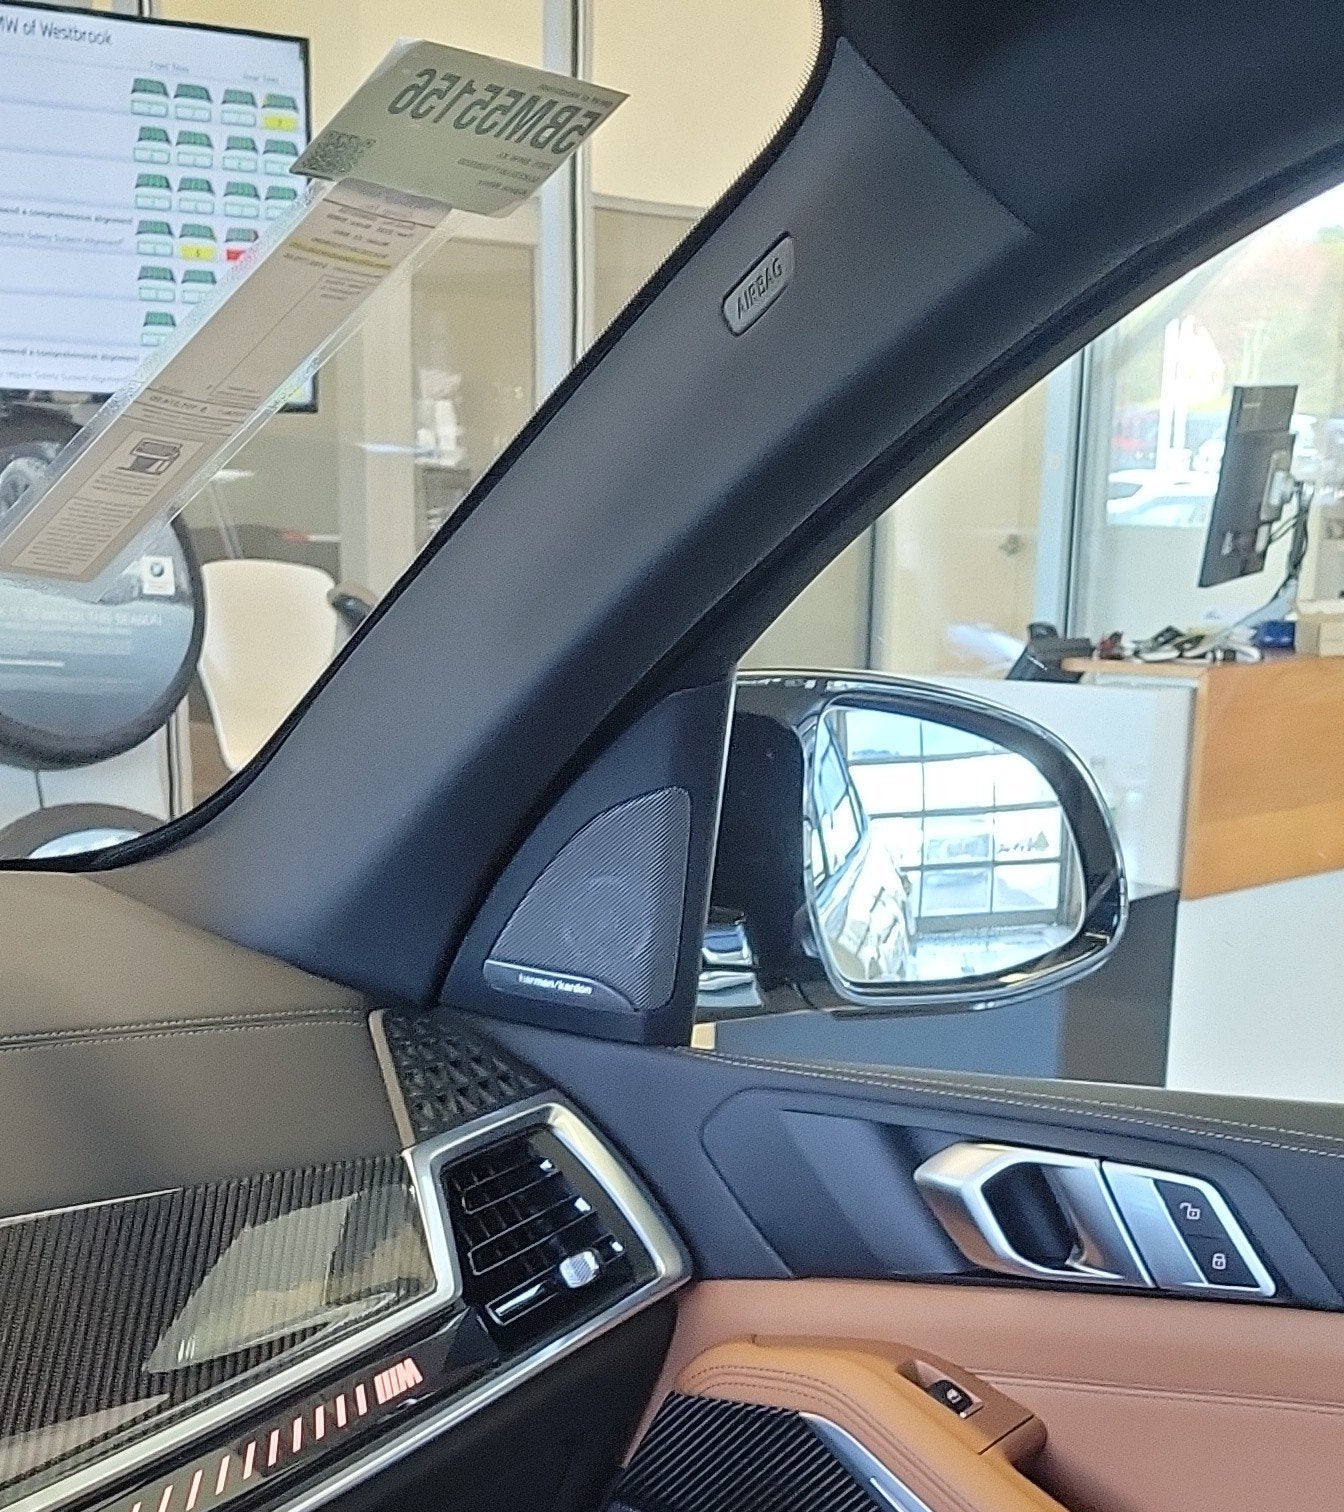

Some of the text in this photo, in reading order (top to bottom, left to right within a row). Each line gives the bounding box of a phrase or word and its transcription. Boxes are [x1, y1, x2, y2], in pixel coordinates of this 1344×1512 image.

[23, 20, 37, 34] of
[41, 23, 113, 45] Westbrook
[737, 257, 783, 320] AIRBAG
[518, 972, 593, 995] harman/kardon
